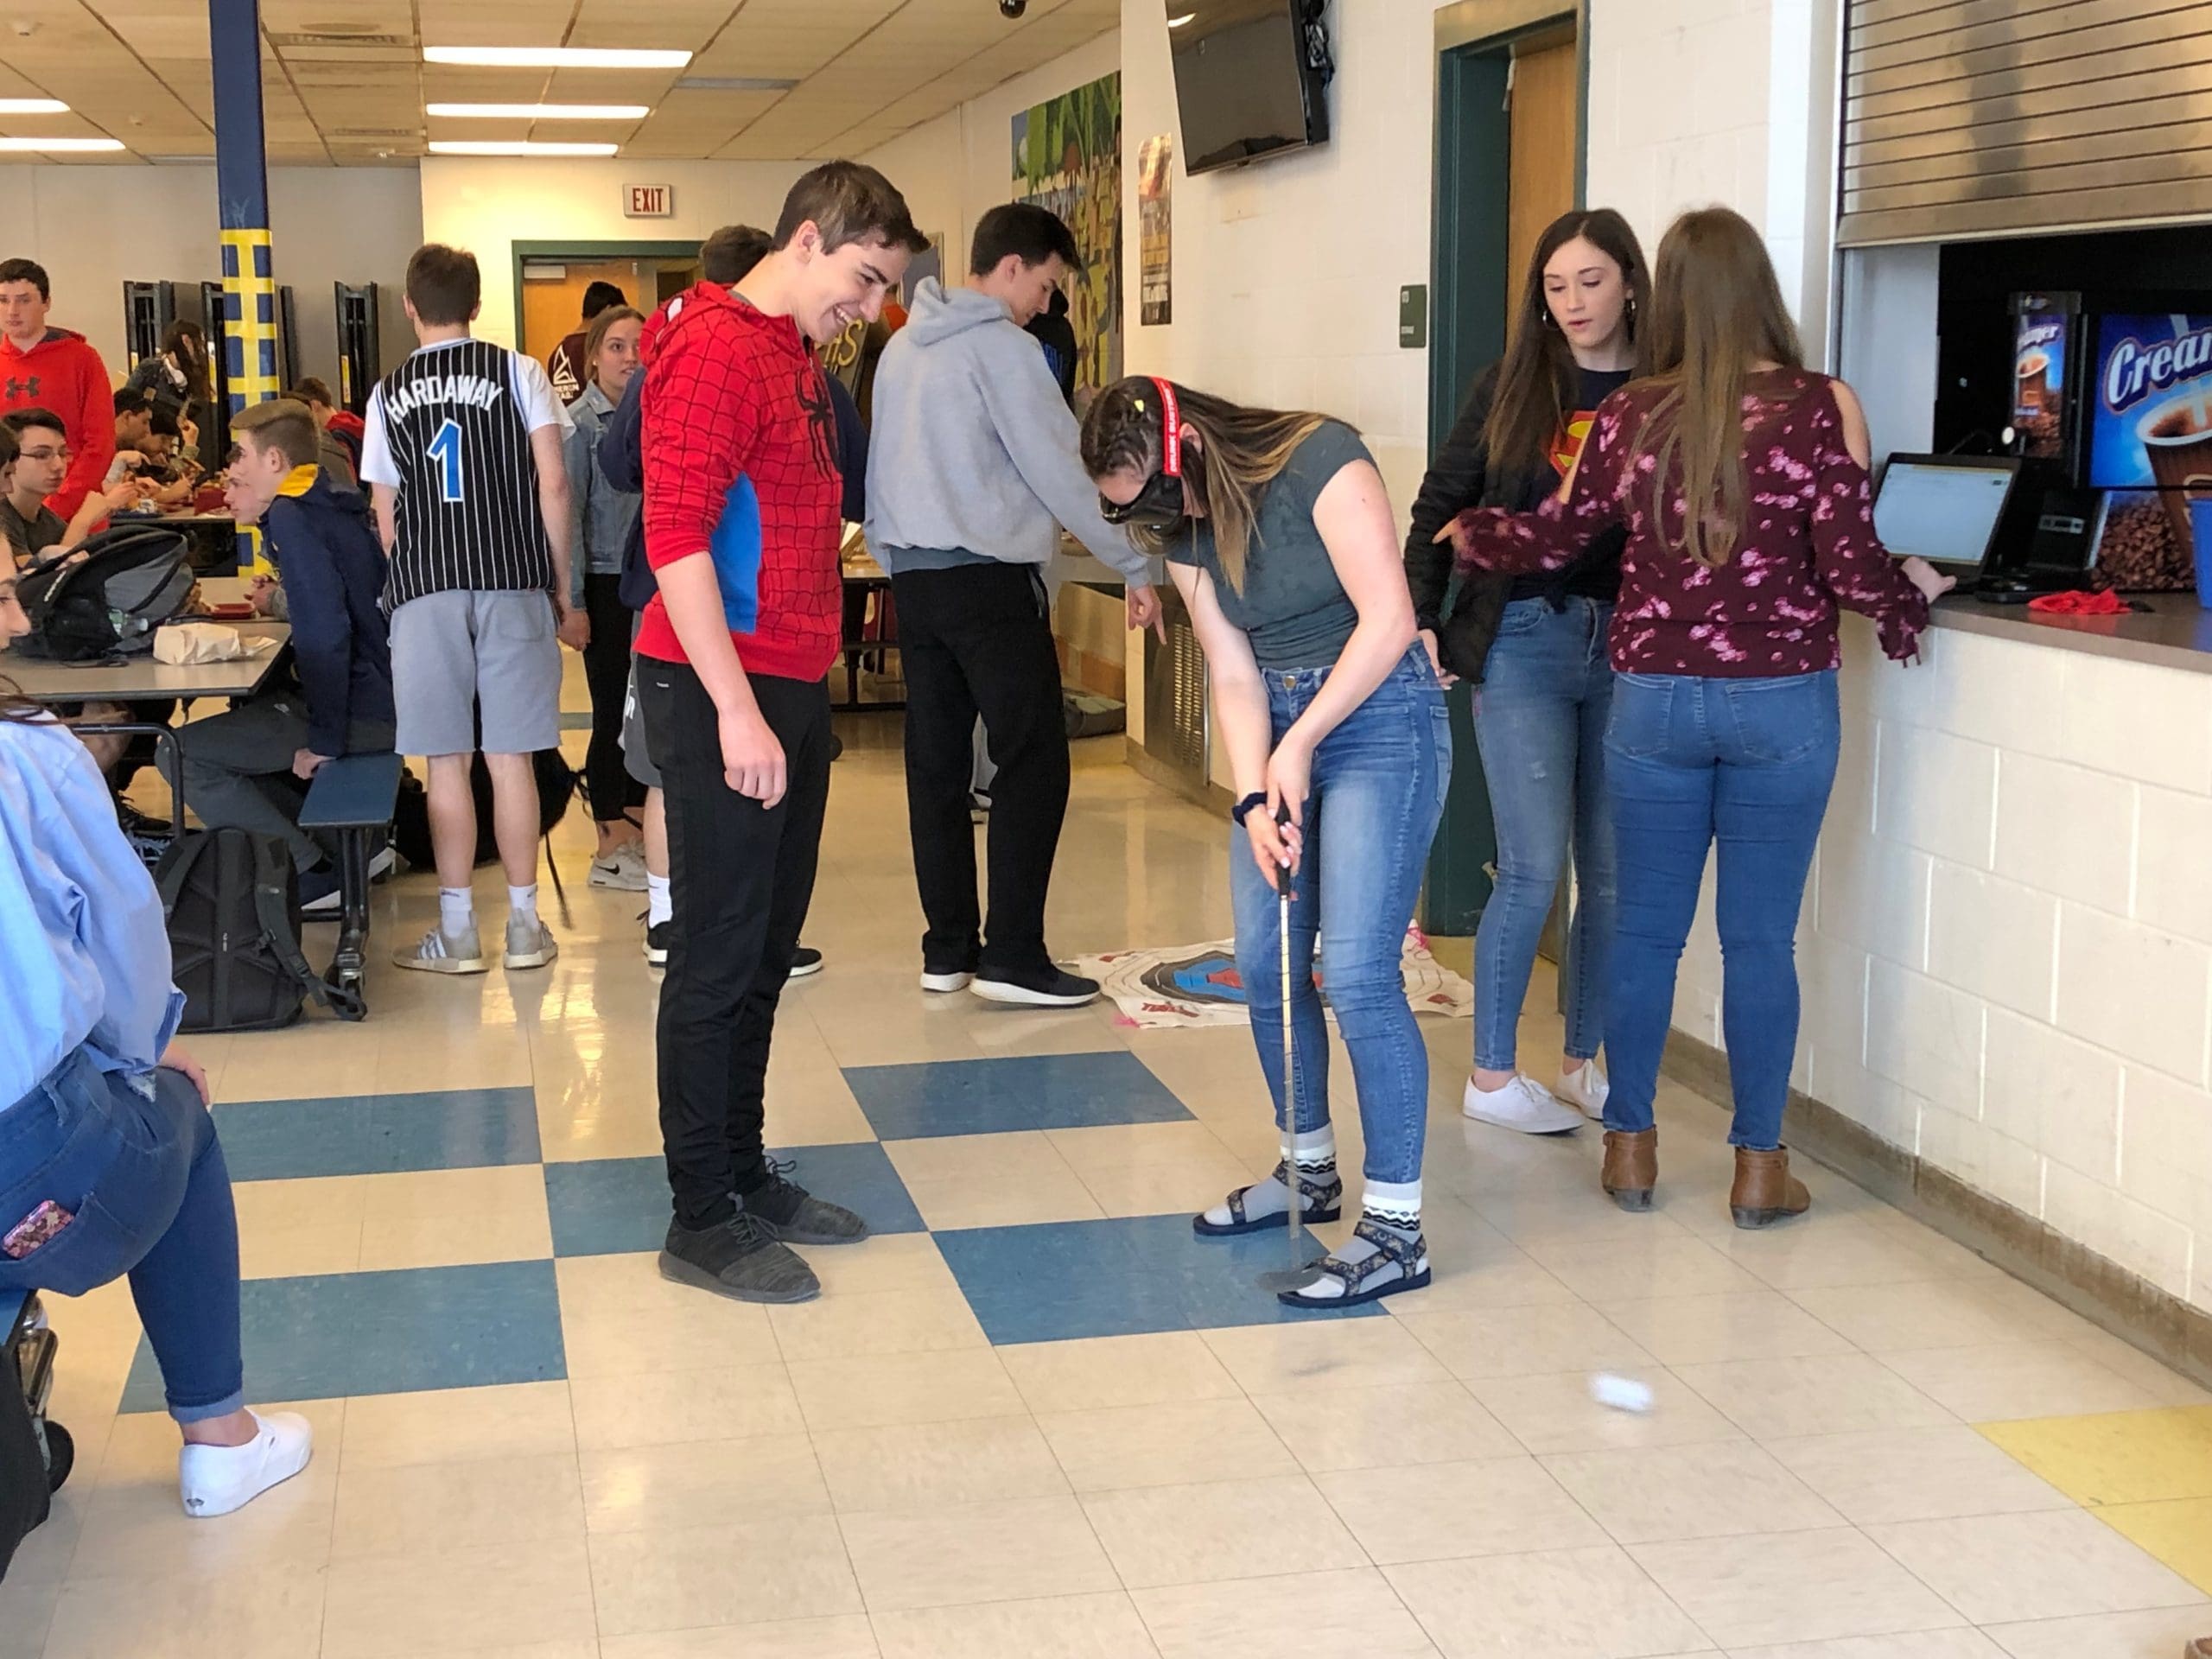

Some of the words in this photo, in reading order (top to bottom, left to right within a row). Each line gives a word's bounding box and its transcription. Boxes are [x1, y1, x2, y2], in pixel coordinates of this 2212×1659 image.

[632, 188, 664, 213] EXIT
[385, 374, 504, 425] HARDAWAY
[426, 417, 464, 502] 1
